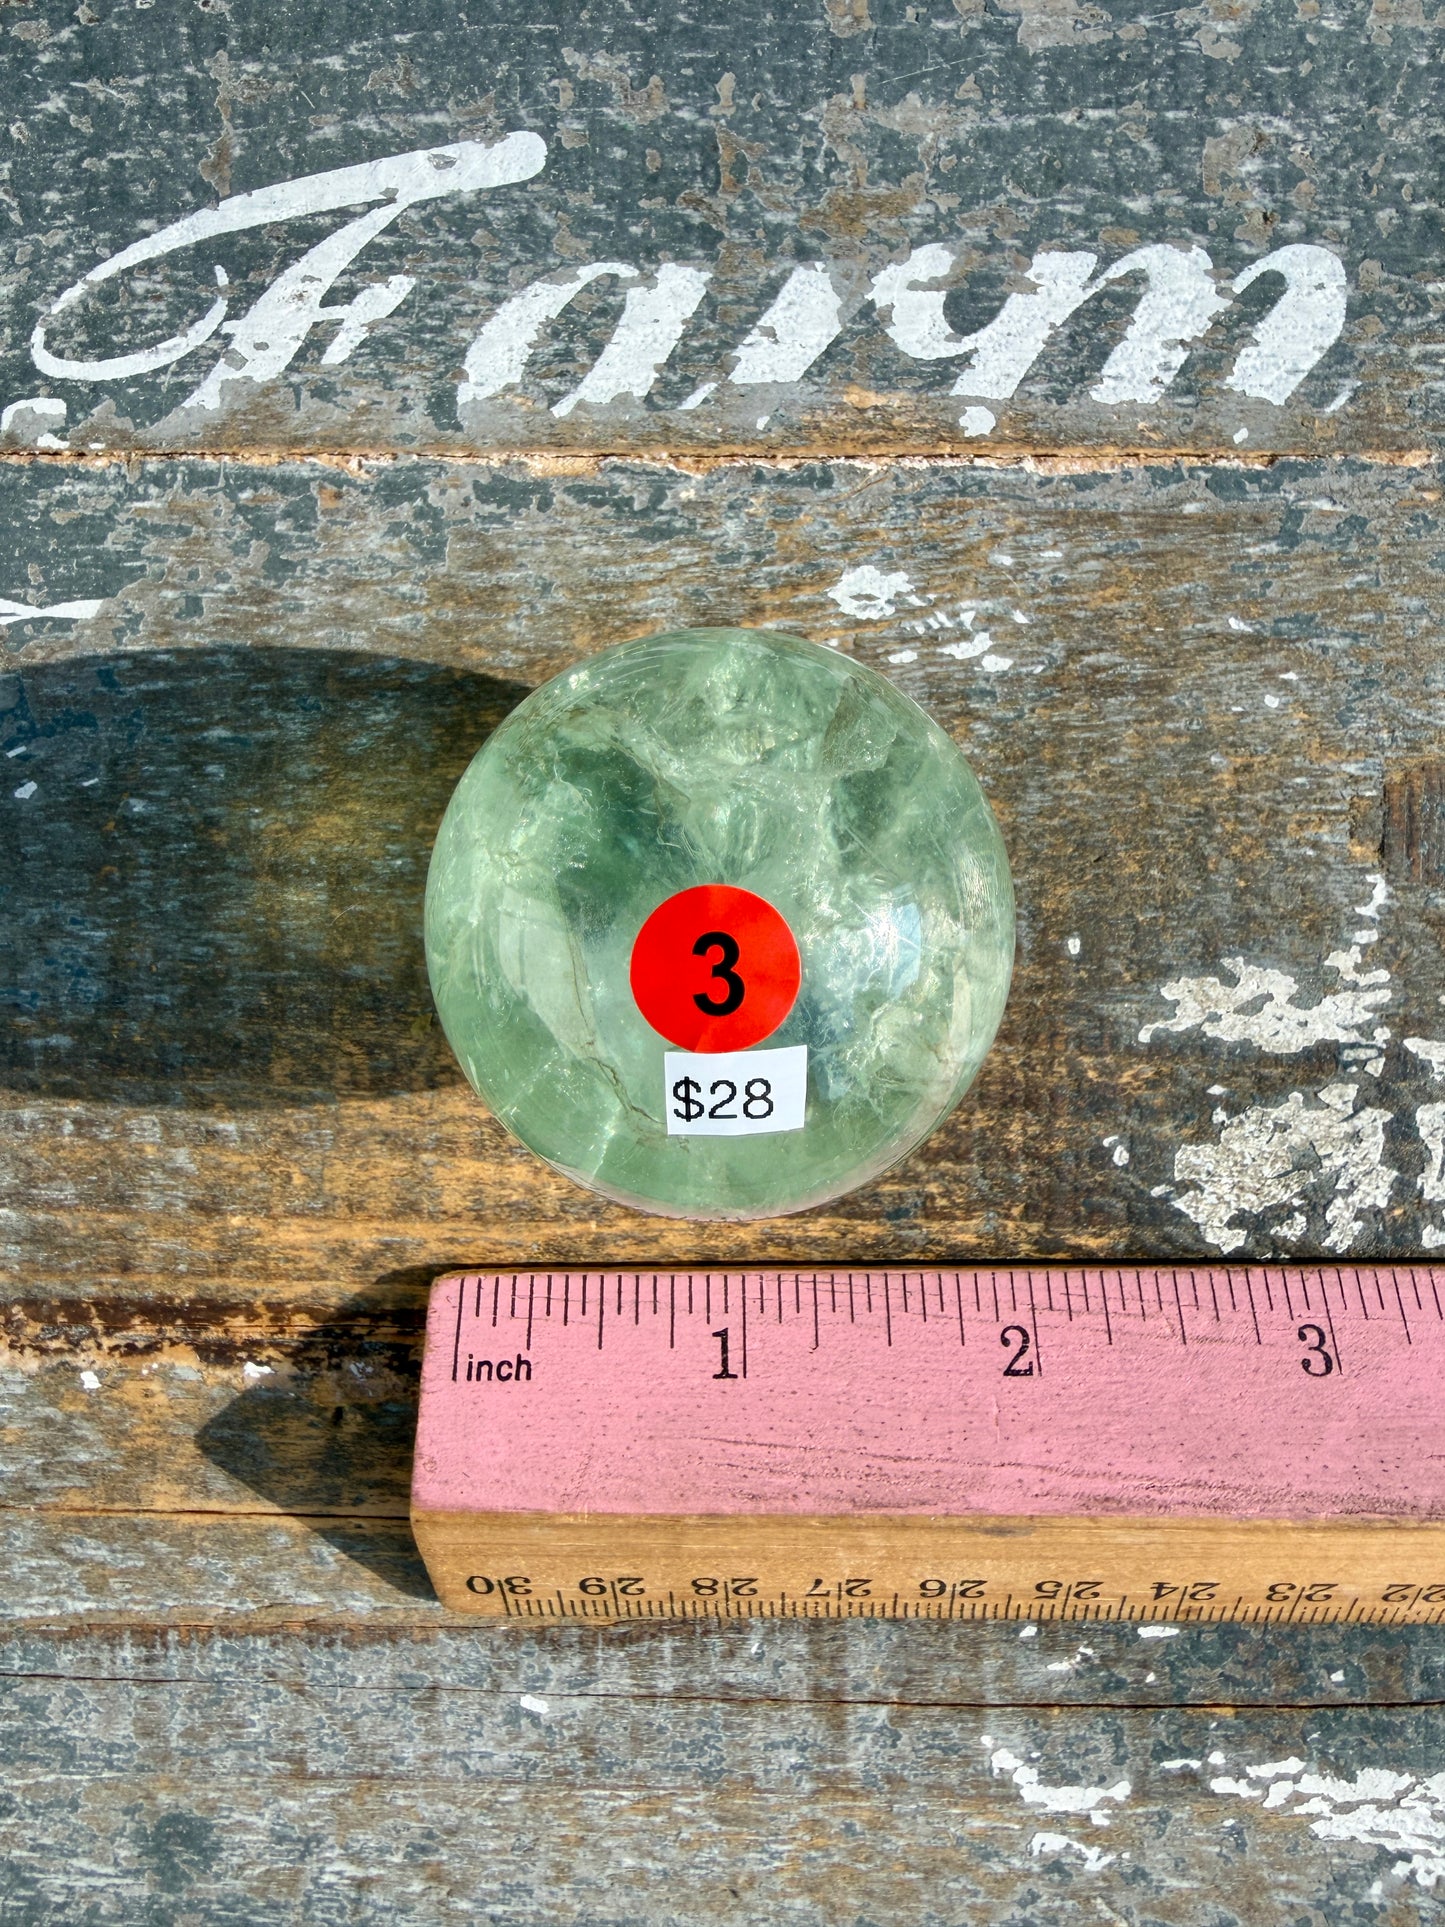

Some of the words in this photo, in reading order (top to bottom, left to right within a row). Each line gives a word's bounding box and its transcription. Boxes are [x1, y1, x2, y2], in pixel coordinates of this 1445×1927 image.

[692, 931, 745, 1016] 3
[672, 1076, 774, 1122] $28
[466, 1353, 532, 1381] inch
[712, 1327, 738, 1379] 1
[1000, 1325, 1034, 1376] 2
[1297, 1324, 1333, 1376] 3
